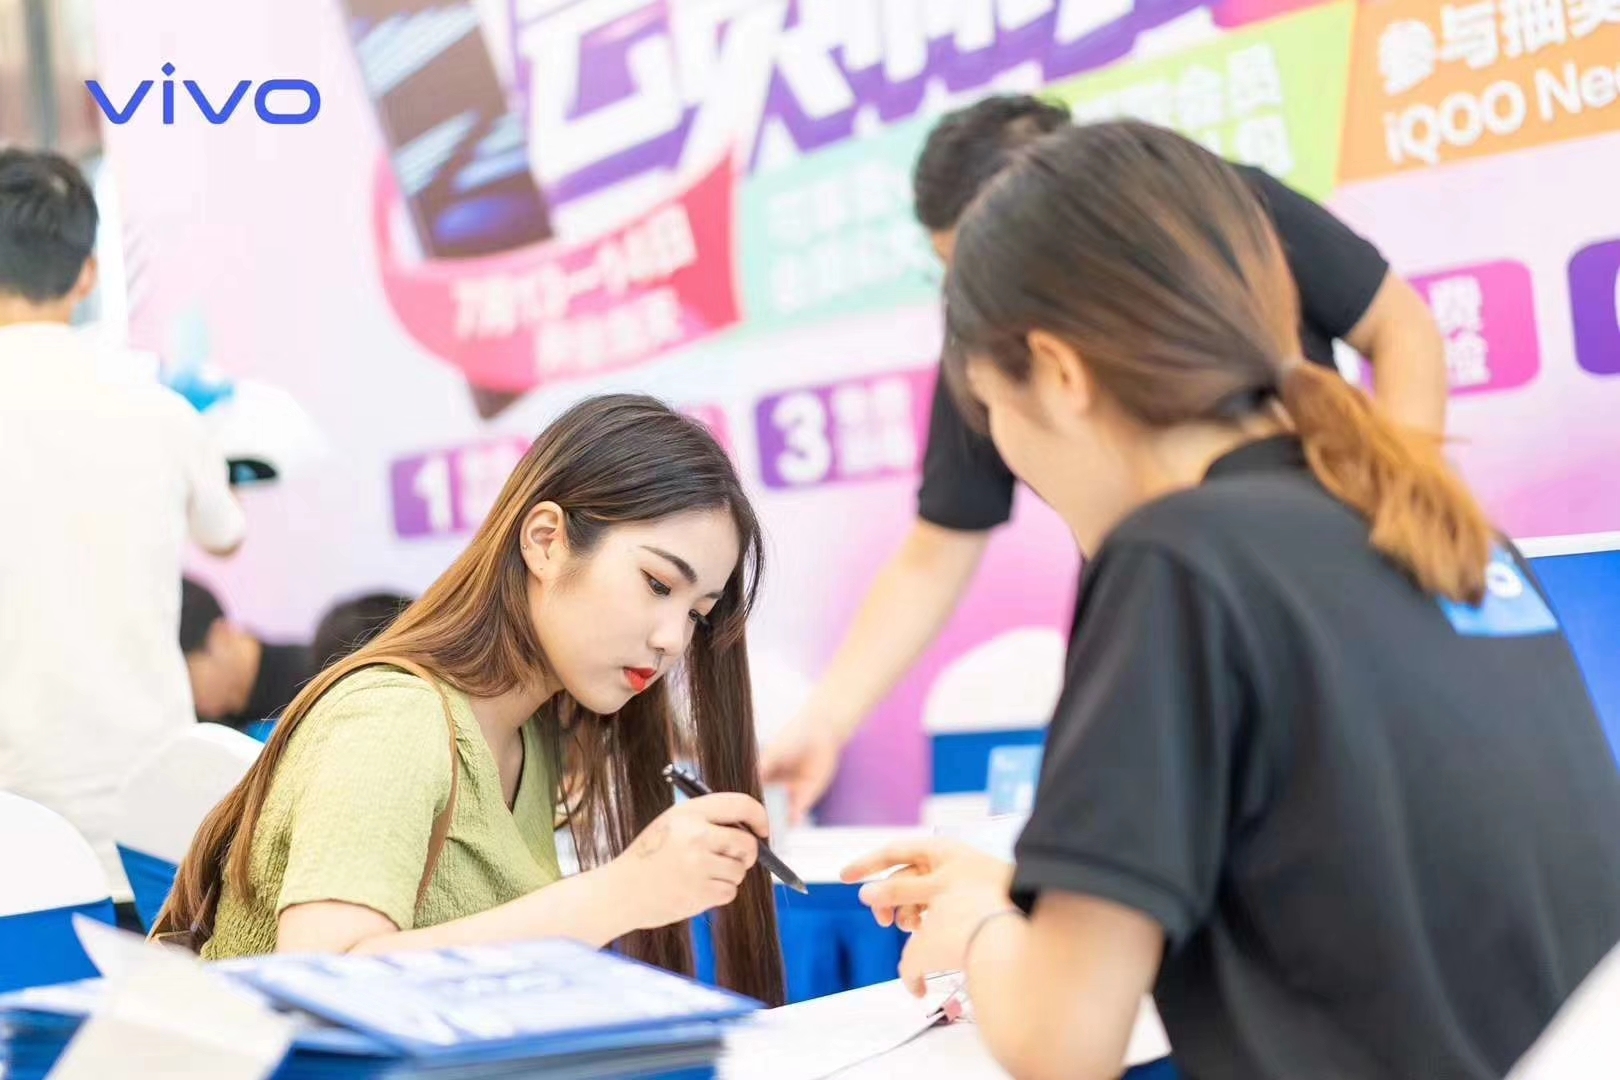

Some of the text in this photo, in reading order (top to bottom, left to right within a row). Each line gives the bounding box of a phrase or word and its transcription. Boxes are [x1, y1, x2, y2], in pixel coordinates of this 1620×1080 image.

[1383, 60, 1620, 166] iQOO Ne
[773, 390, 833, 485] 3
